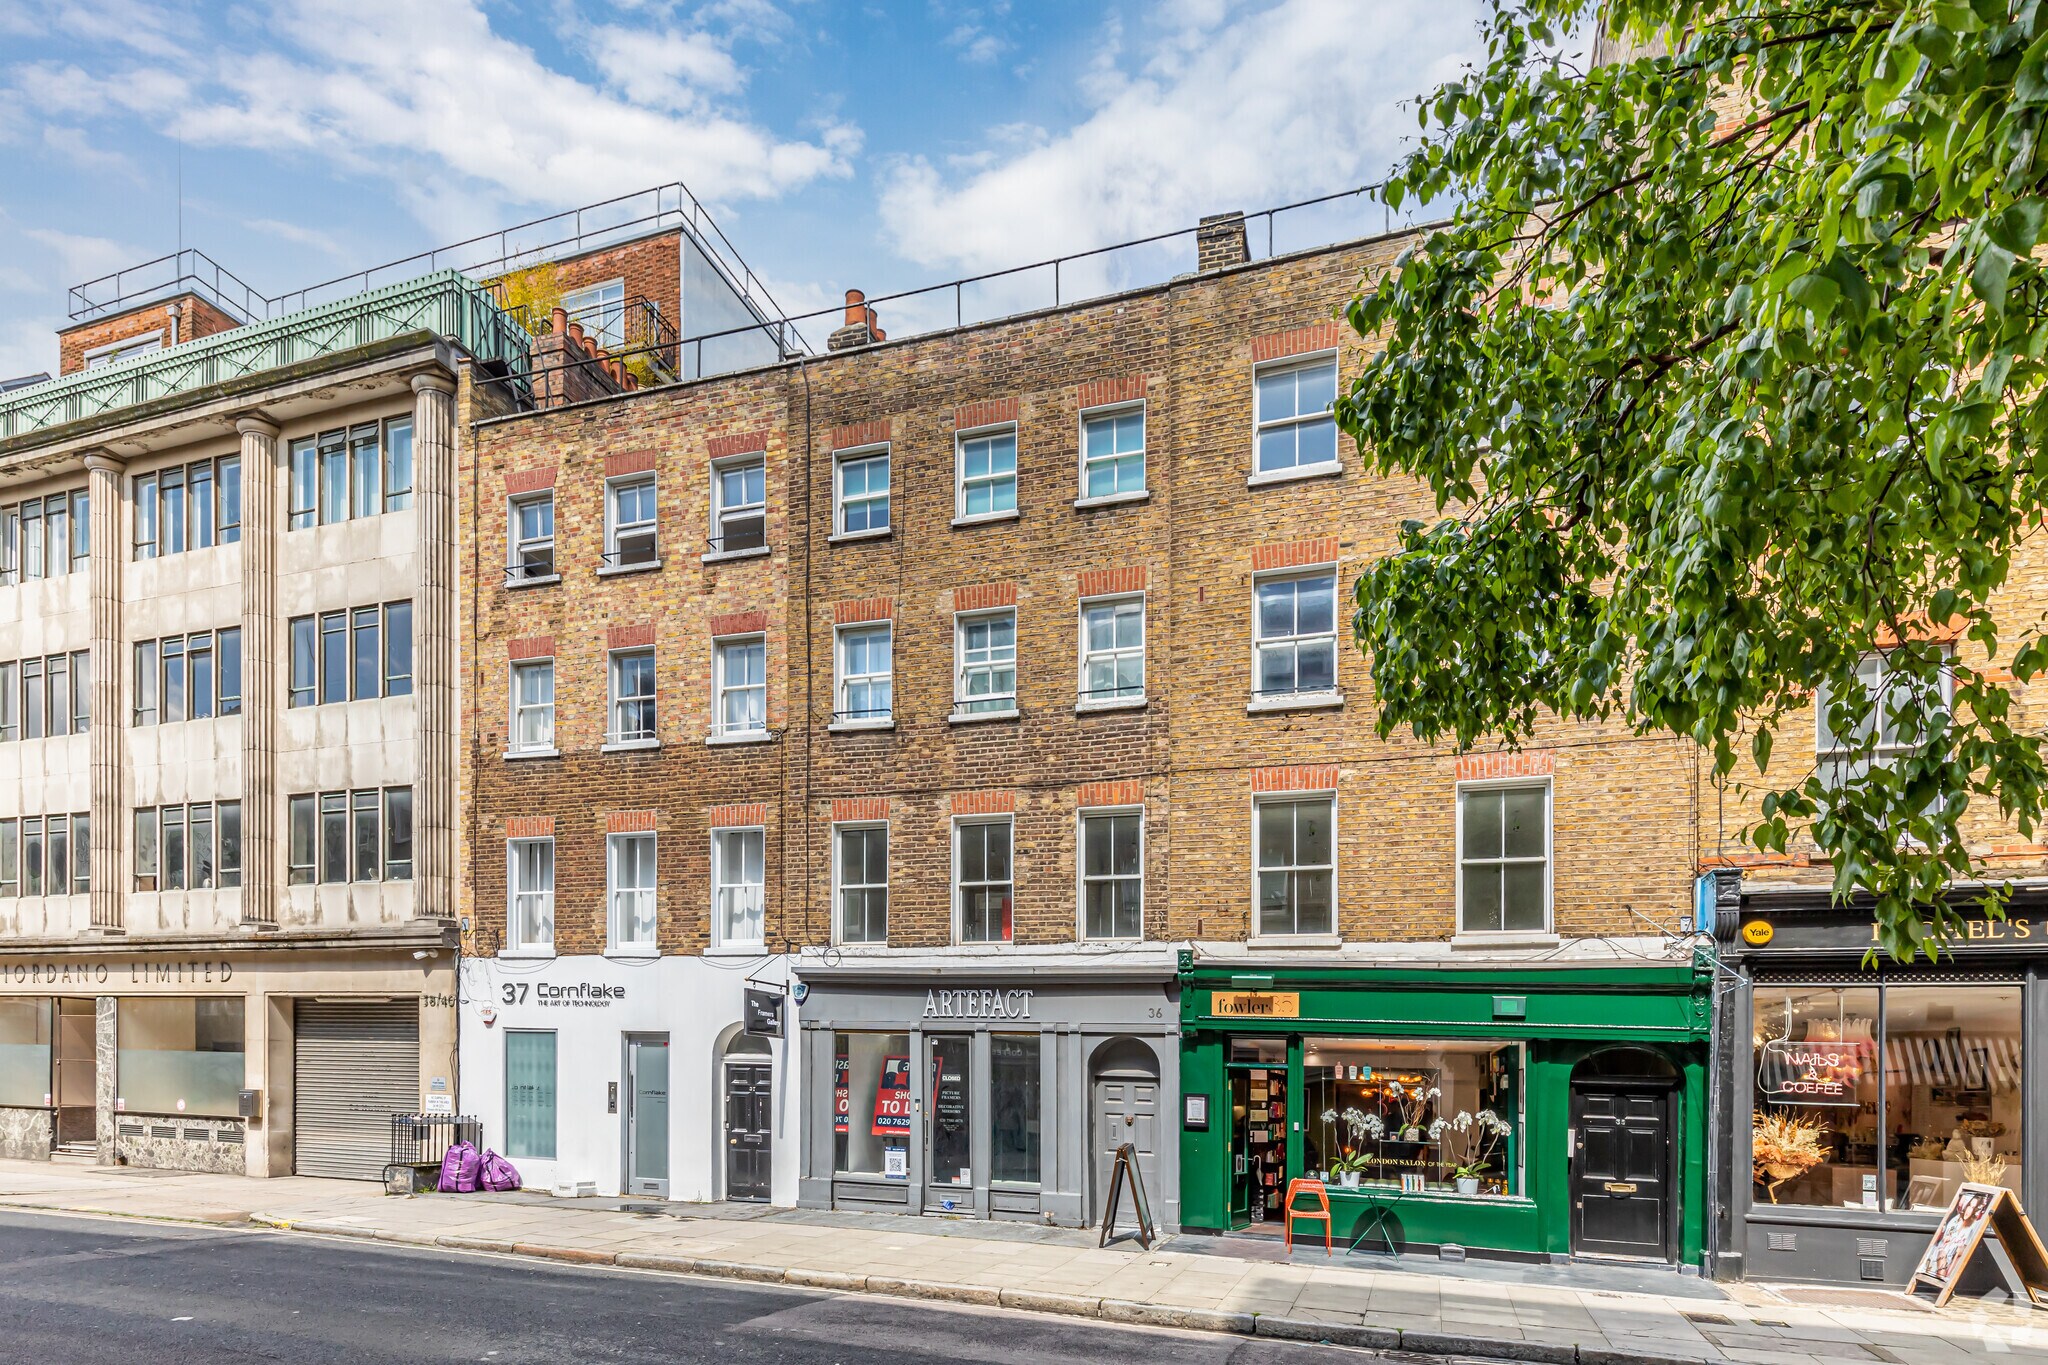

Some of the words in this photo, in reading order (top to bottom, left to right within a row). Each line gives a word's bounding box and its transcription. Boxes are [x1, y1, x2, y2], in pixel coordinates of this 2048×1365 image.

[1749, 928, 1770, 937] Yale
[131, 961, 233, 983] LIMITED
[501, 983, 530, 1006] 37
[537, 982, 626, 999] Cornflake
[537, 999, 549, 1007] THE
[549, 999, 561, 1007] ART
[562, 999, 571, 1007] OF
[572, 999, 611, 1008] TECHNOLOGY
[750, 1000, 760, 1008] The
[922, 988, 1034, 1019] ARTEFACT
[757, 1009, 774, 1018] Framers
[1148, 1008, 1163, 1019] 36
[766, 1018, 781, 1027] Gallery
[1785, 1052, 1840, 1067] NAILS
[881, 1100, 904, 1114] TO
[877, 1117, 892, 1125] 020
[892, 1118, 910, 1126] 7629
[1615, 1118, 1626, 1126] 35
[1366, 1157, 1398, 1165] LONDON
[1399, 1159, 1426, 1168] SALON
